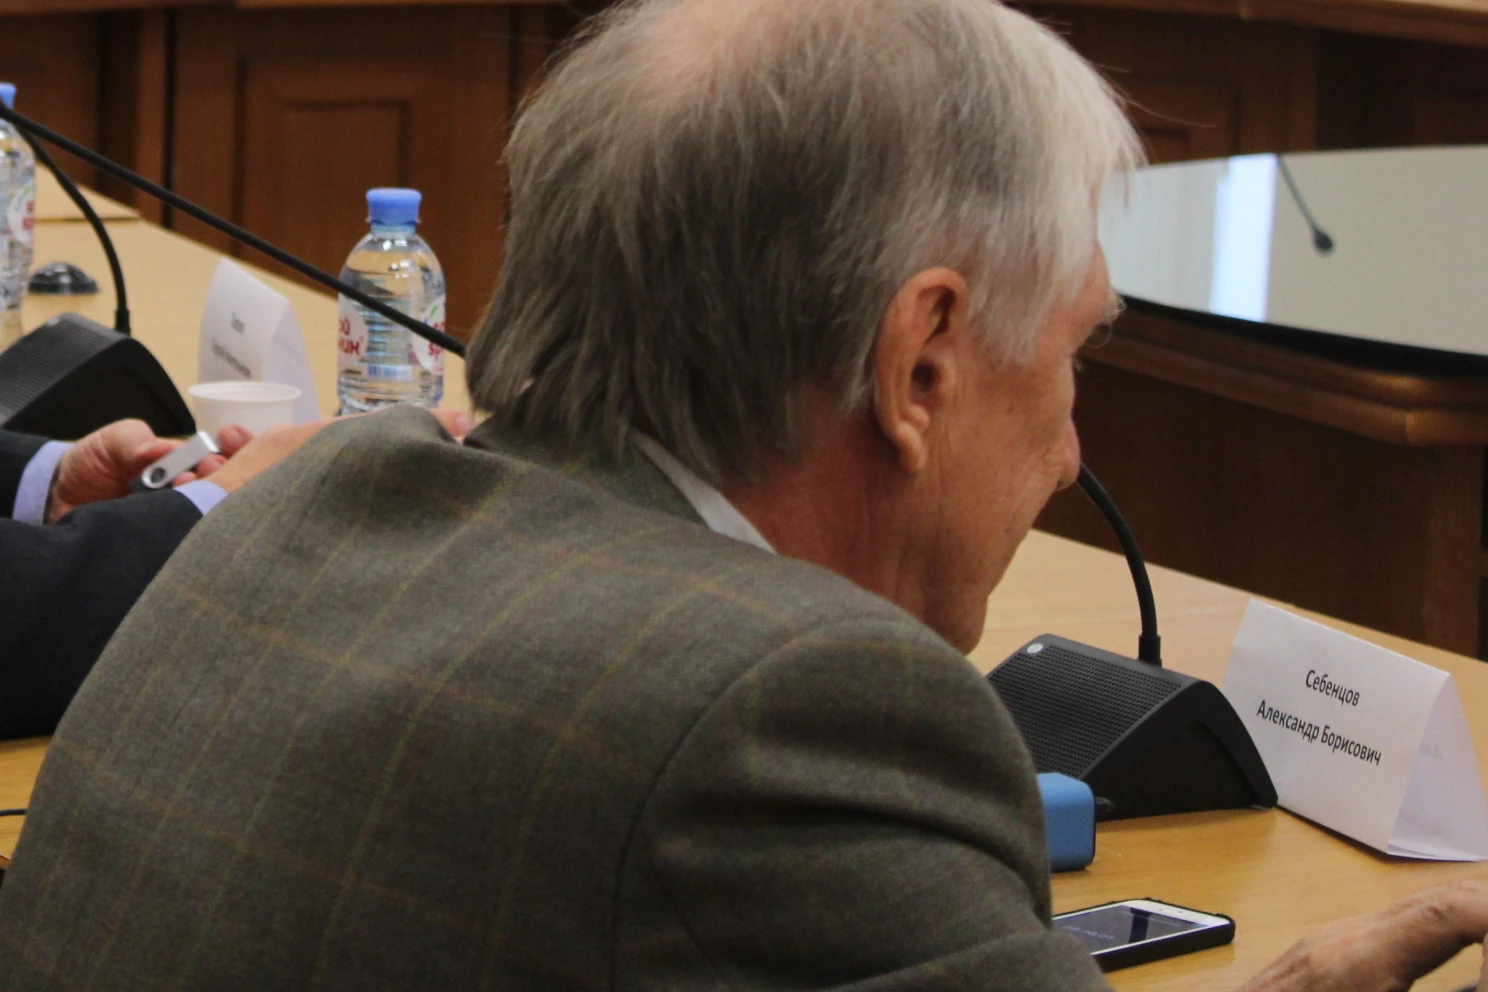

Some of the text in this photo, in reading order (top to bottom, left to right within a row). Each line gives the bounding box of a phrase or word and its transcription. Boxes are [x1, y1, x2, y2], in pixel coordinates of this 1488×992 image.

[1305, 669, 1361, 707] Себенцов
[1256, 699, 1382, 767] Александр Борисович
